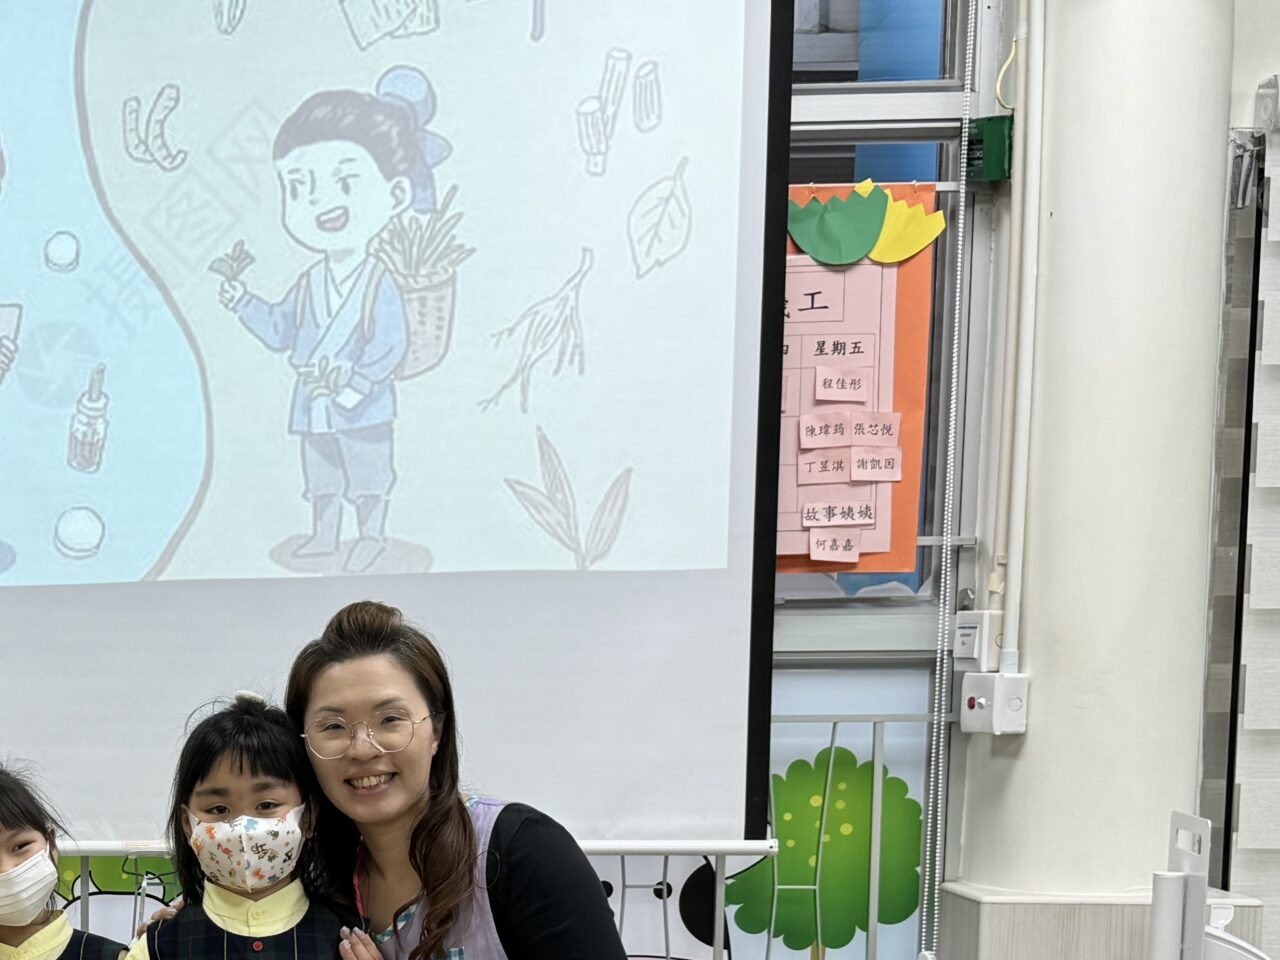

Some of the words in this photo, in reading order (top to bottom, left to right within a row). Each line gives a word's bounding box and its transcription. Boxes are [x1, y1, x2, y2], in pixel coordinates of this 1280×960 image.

[813, 340, 865, 356] 星期五
[805, 504, 873, 522] 故事姨姨
